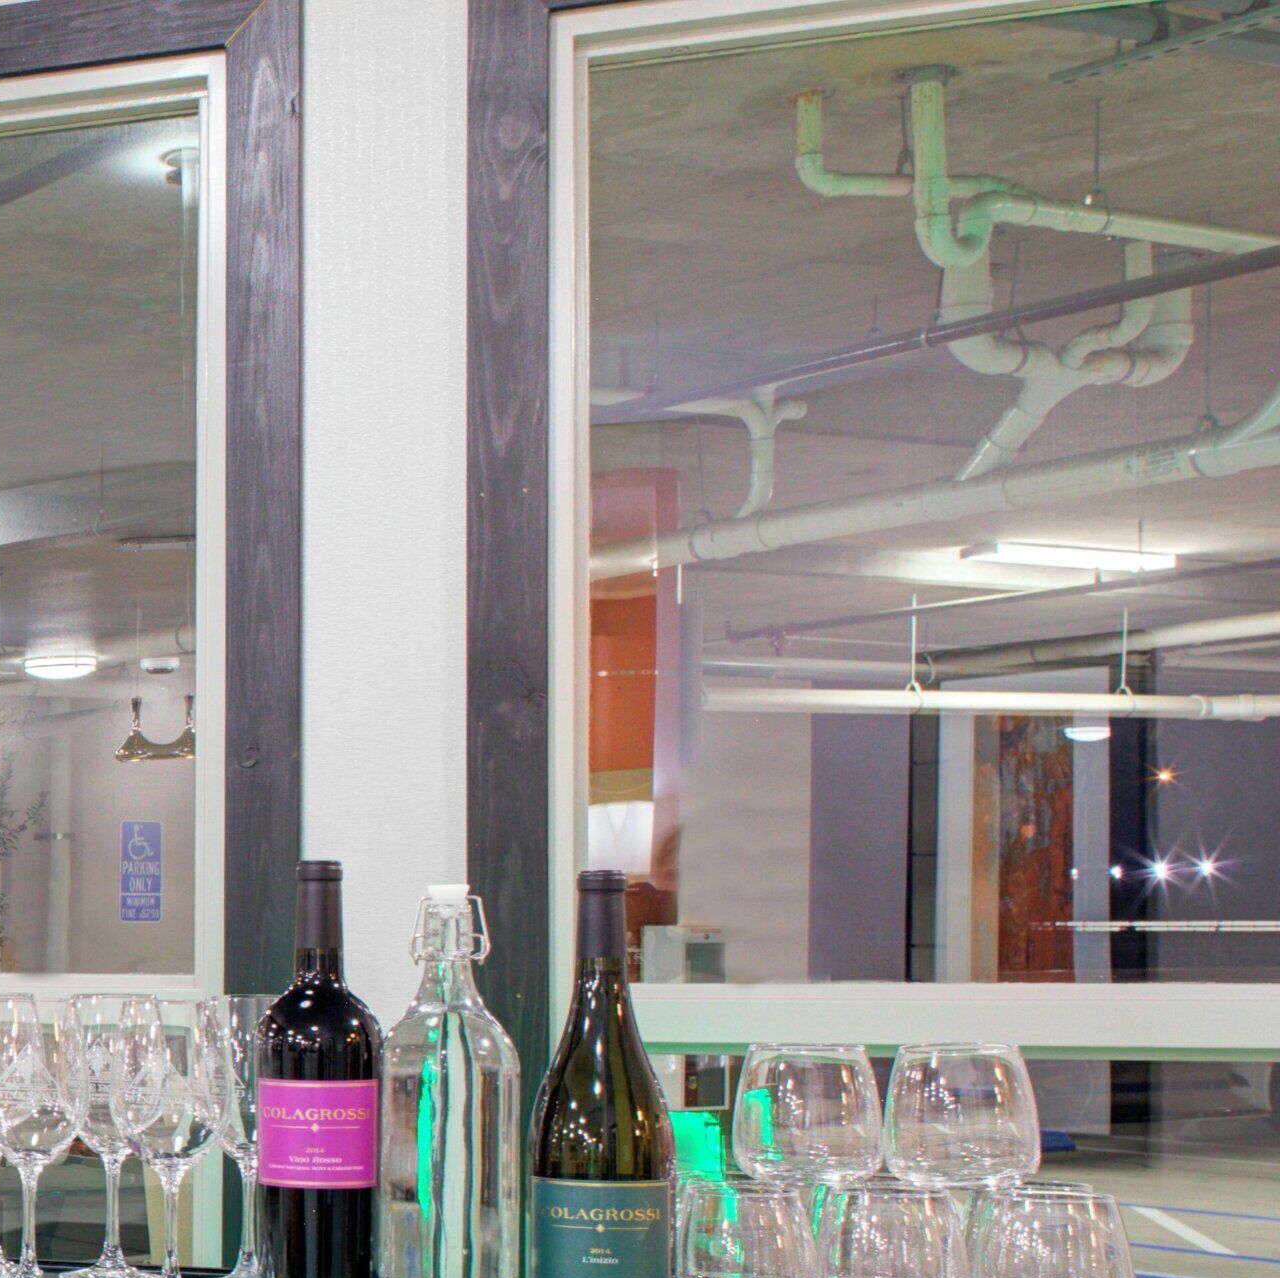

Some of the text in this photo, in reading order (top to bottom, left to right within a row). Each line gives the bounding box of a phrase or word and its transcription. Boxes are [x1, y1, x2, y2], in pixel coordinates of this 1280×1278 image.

[122, 861, 160, 876] PARKING
[129, 877, 153, 892] ONLY
[126, 897, 155, 907] MINIMUM
[122, 909, 137, 919] FINE
[289, 1155, 343, 1164] Vino Rosso
